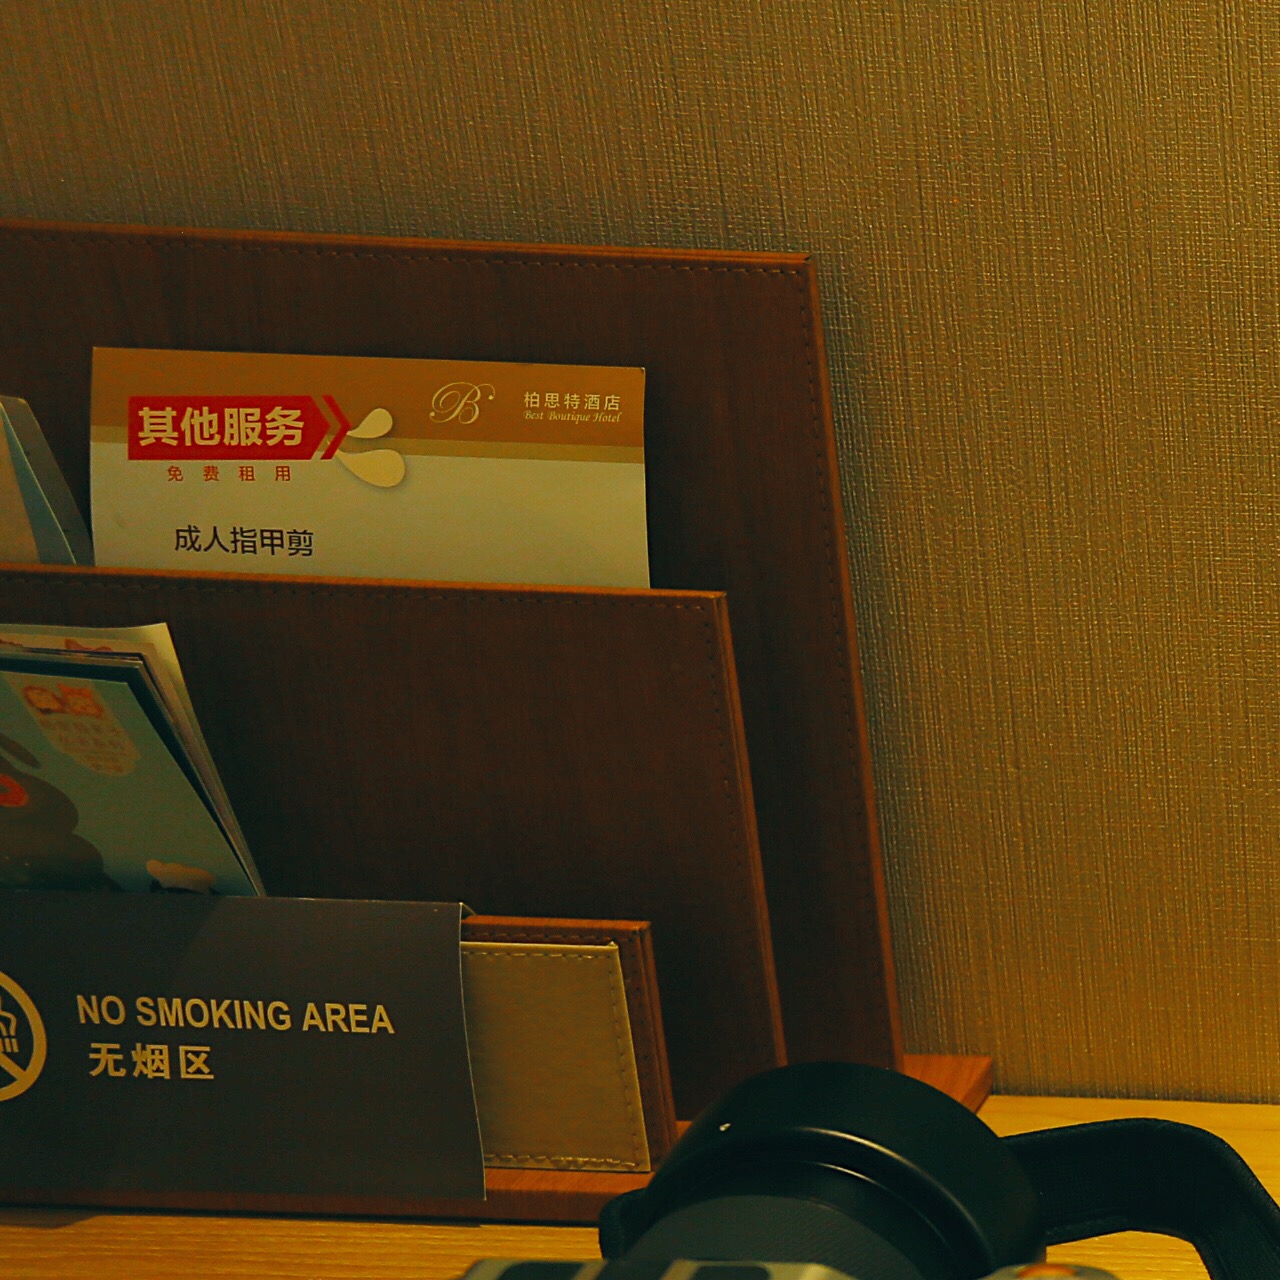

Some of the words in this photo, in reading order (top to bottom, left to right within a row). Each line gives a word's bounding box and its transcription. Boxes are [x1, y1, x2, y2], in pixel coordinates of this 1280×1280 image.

[523, 391, 621, 411] 柏思特酒店
[523, 410, 545, 420] Best
[547, 411, 591, 425] Boutique
[592, 412, 623, 423] Hotel
[136, 405, 305, 448] 其他服务
[173, 524, 315, 558] 成人指甲剪
[76, 994, 126, 1025] NO
[135, 997, 292, 1031] SMOKING
[302, 1002, 395, 1035] AREA
[88, 1042, 215, 1080] 无烟区
